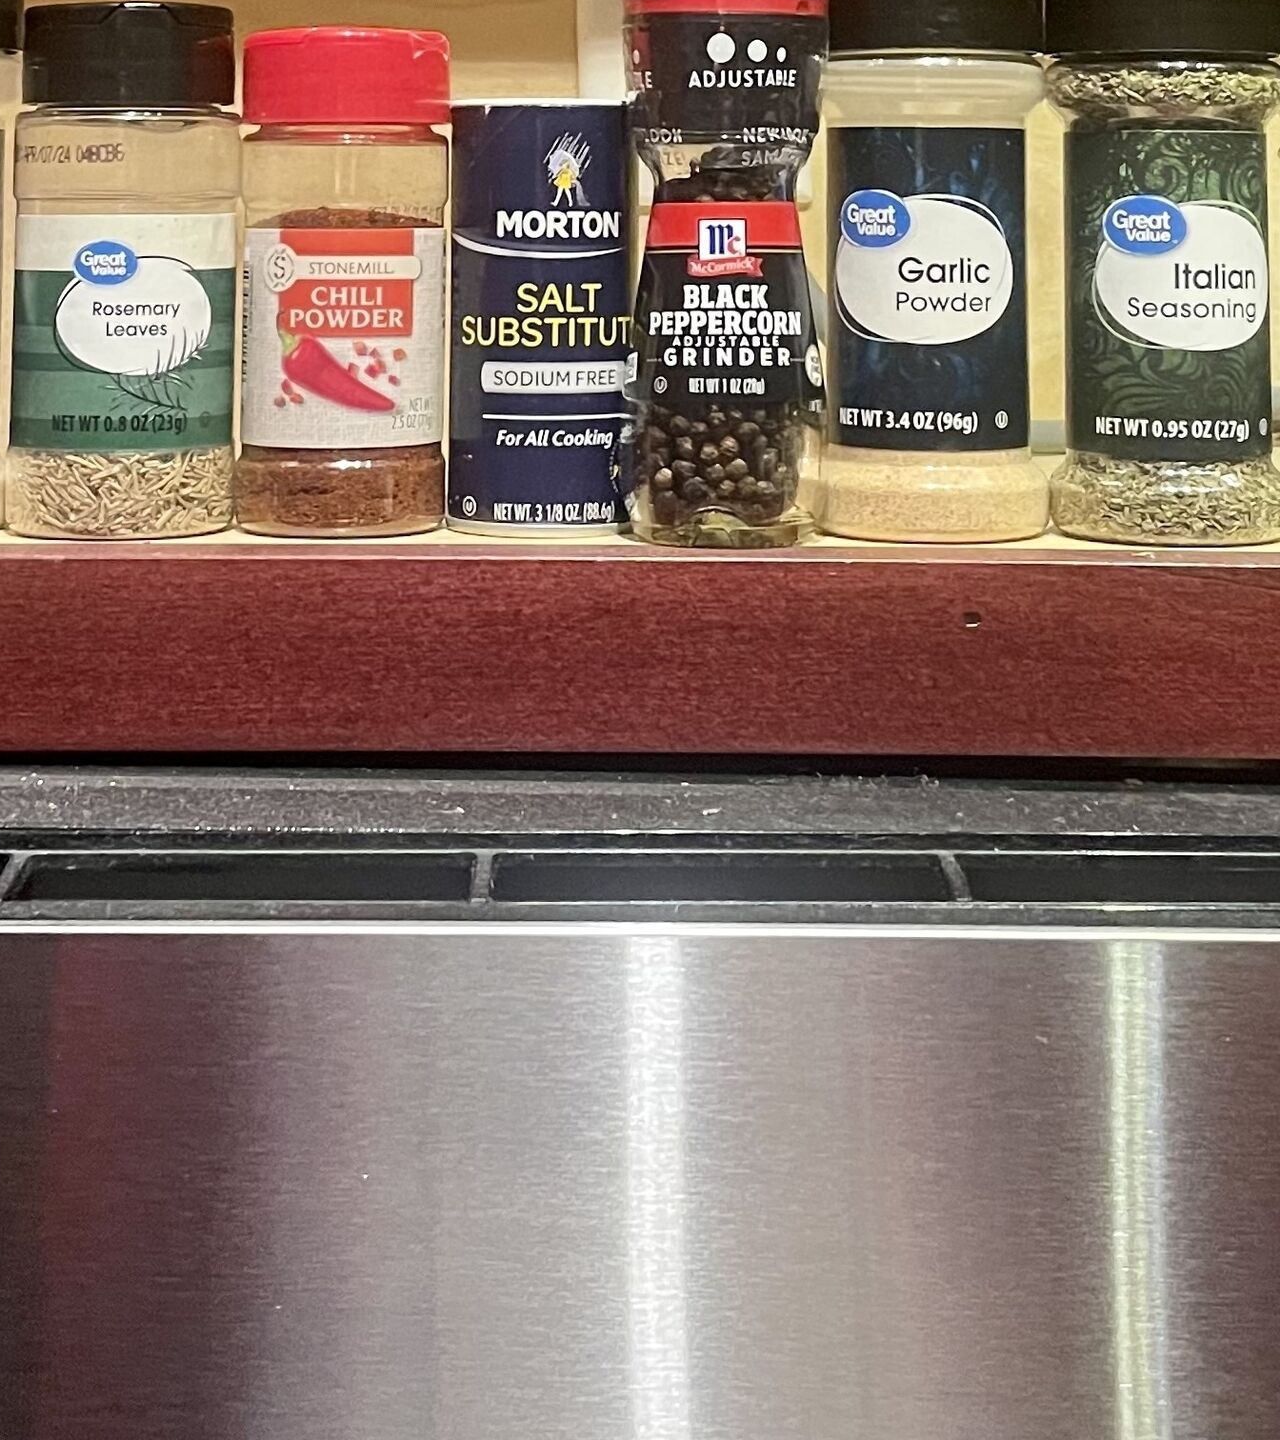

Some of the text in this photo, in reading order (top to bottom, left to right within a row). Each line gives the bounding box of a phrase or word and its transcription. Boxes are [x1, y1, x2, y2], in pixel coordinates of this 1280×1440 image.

[688, 69, 797, 88] ADJUSTABLE
[847, 204, 895, 224] Great
[1112, 211, 1171, 230] Great
[496, 210, 619, 239] MORTON
[858, 222, 895, 237] Value
[1126, 228, 1171, 243] Value
[80, 250, 127, 267] Great
[309, 262, 394, 275] STONEMILL
[690, 258, 754, 274] McCormick
[90, 262, 128, 276] Value
[898, 257, 990, 283] Garlic
[1174, 263, 1256, 290] Italian
[310, 286, 383, 306] CHILI
[516, 282, 602, 314] SALT
[683, 284, 768, 309] BLACK
[897, 292, 991, 311] Powder
[93, 300, 180, 321] Rosemary
[289, 309, 404, 328] POWDER
[1128, 297, 1257, 323] Seasoning
[106, 320, 168, 337] Leaves
[462, 316, 631, 348] SUBSTITUT
[649, 311, 801, 335] PEPPERCORN
[672, 336, 780, 347] ADJUSTABLE
[664, 347, 791, 366] GRINDER
[493, 369, 616, 387] SODIUM FREE
[51, 414, 74, 432] NET
[77, 415, 101, 433] WT
[131, 415, 149, 433] OZ
[151, 414, 188, 436] (23g)
[840, 407, 978, 435] NET WT 3.4 OZ (96g)
[1095, 416, 1250, 442] NET WT 0.95 OZ (27g)
[496, 429, 613, 449] For All Cooking
[493, 502, 513, 522] NET
[514, 502, 533, 522] WT.
[535, 502, 543, 521] 3
[546, 503, 564, 522] 1/8
[565, 503, 582, 521] OZ.
